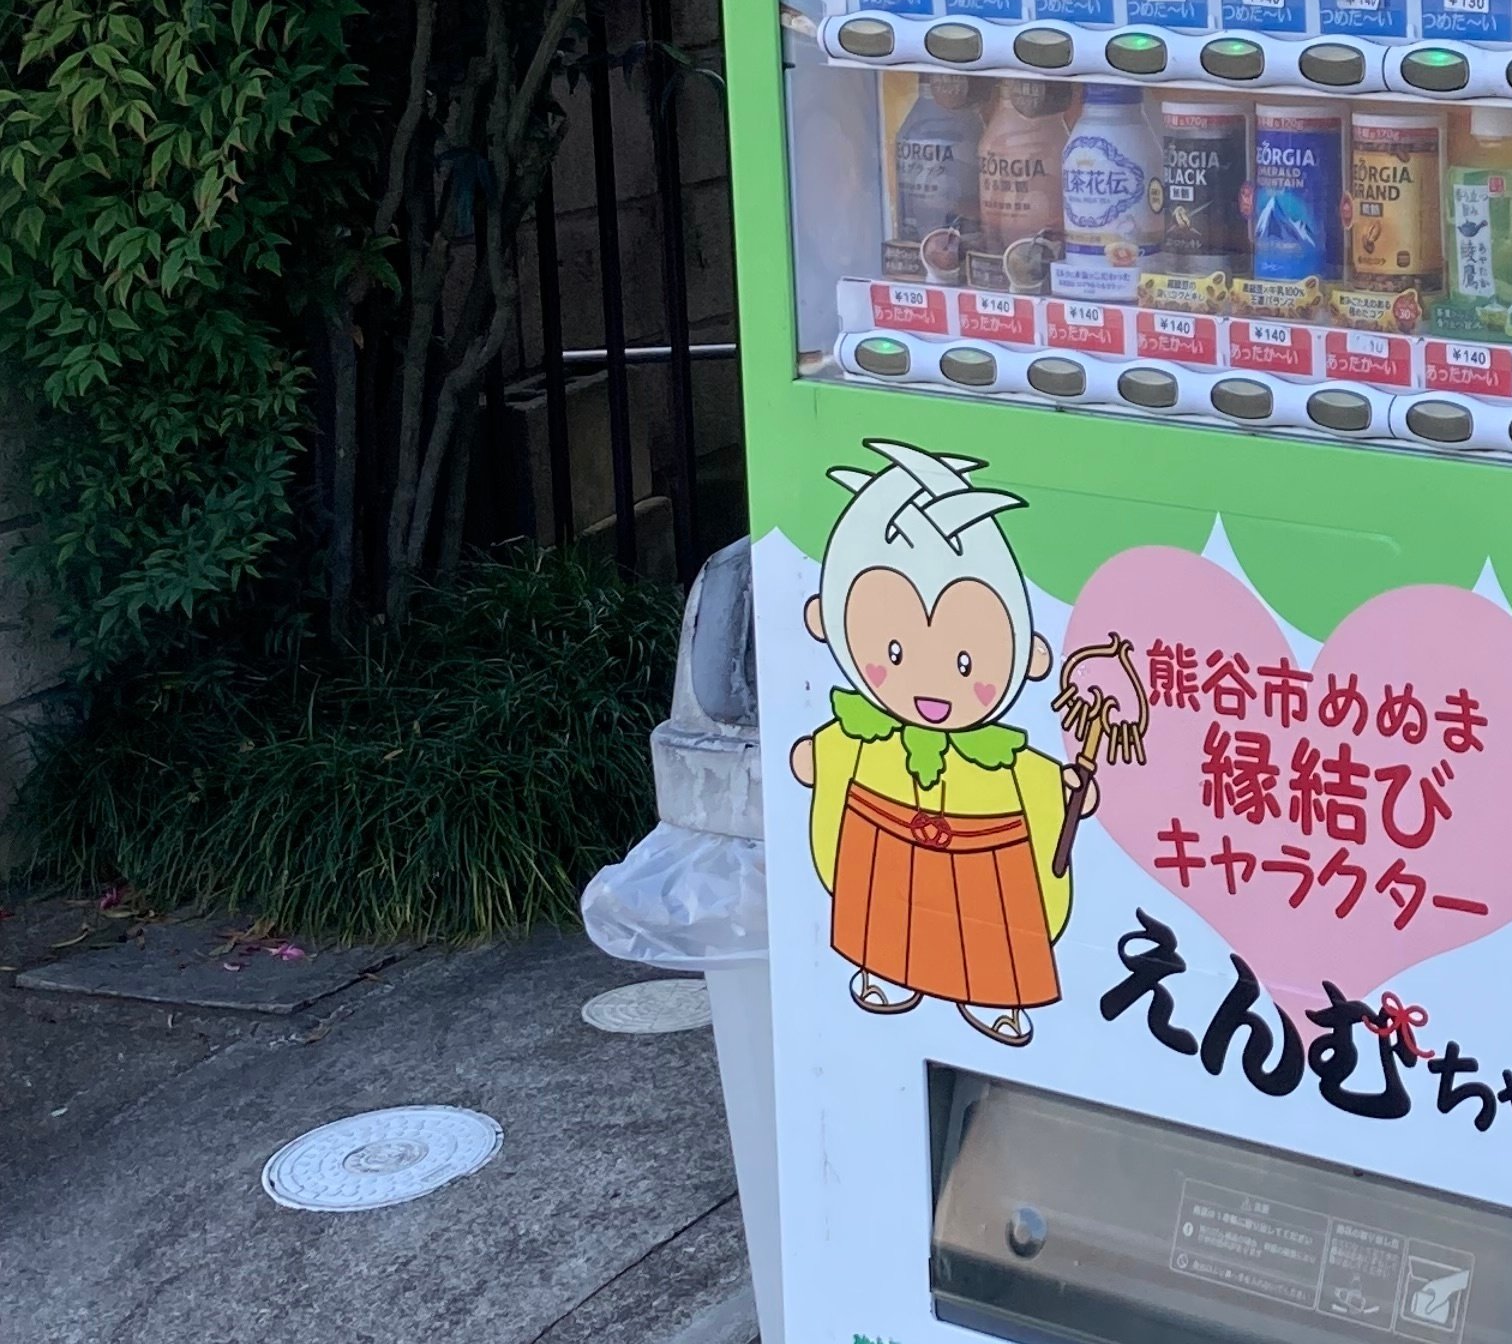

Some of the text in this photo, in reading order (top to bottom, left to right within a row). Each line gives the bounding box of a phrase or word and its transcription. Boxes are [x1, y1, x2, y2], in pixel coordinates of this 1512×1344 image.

[894, 290, 924, 305] ¥130
[981, 296, 1010, 313] ¥140
[1069, 306, 1099, 322] ¥140
[1160, 318, 1191, 335] ¥140
[1254, 327, 1286, 343] ¥140
[1452, 347, 1487, 365] ¥140
[1145, 637, 1489, 754] 熊谷市めぬま
[1200, 720, 1455, 850] 縁結び
[1154, 817, 1489, 931] キャラクター
